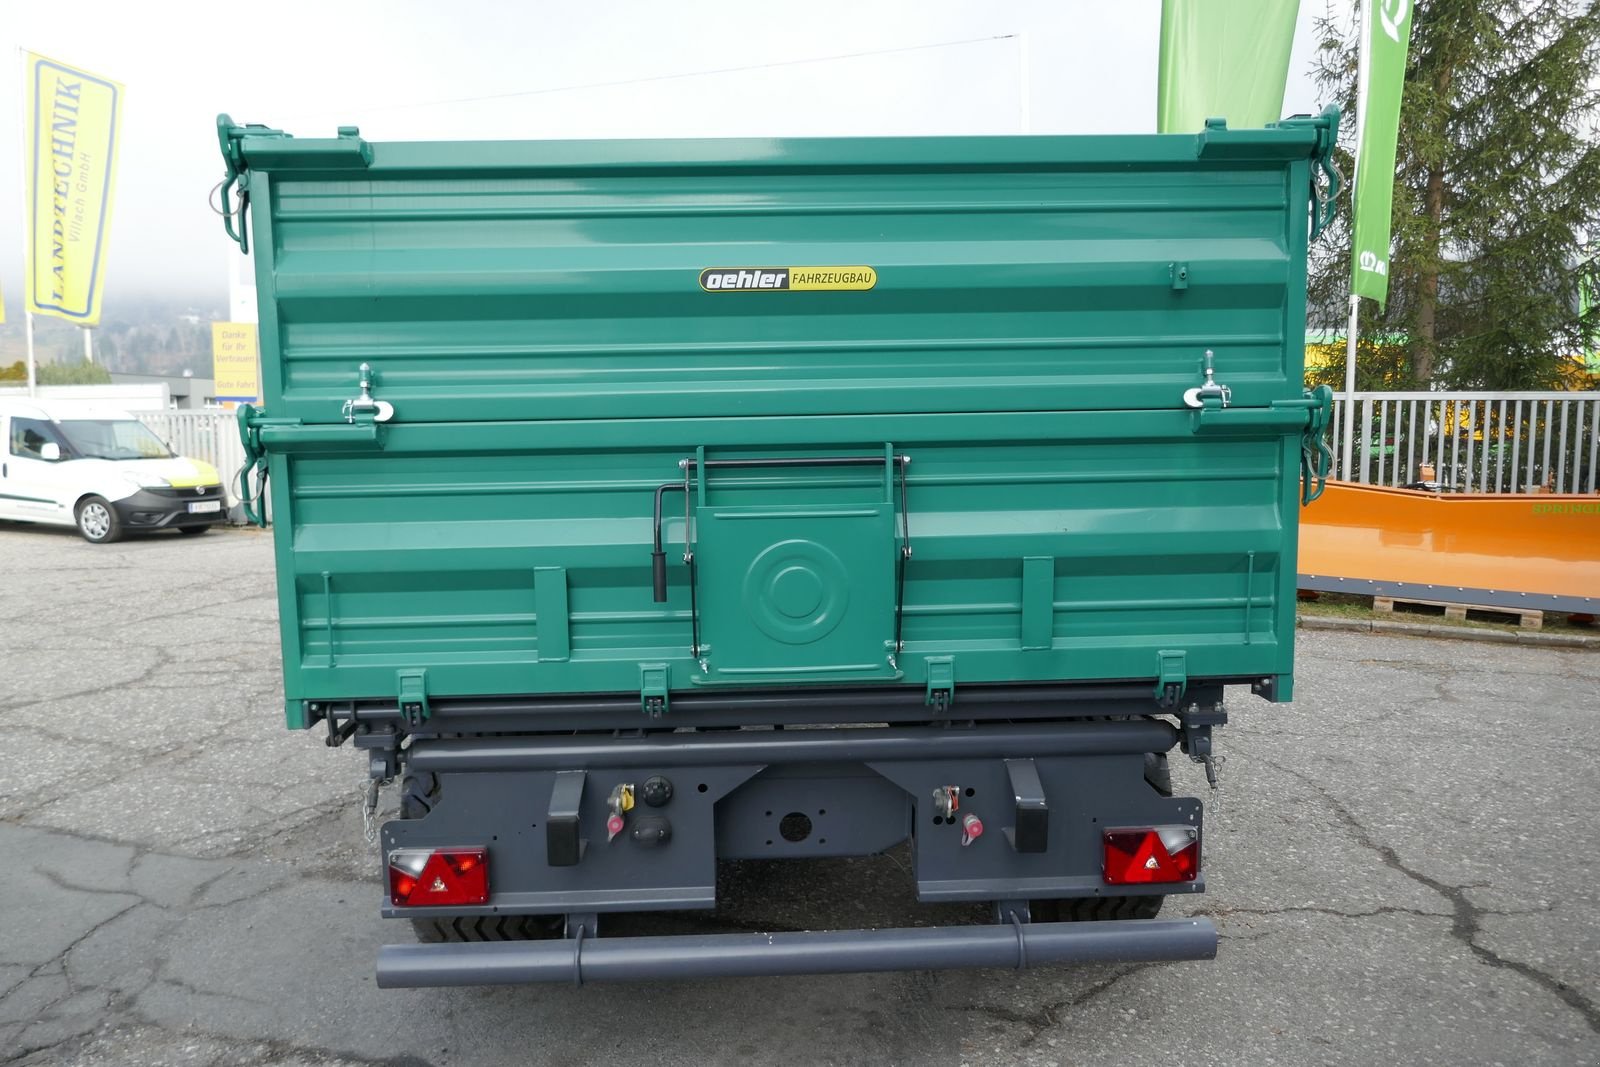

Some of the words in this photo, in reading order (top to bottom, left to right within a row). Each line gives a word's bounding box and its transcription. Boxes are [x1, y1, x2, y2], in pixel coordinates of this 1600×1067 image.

[51, 76, 82, 302] LANDTECHNIK
[67, 197, 85, 243] Villach
[77, 153, 92, 193] GmbH
[706, 270, 786, 289] oehler
[792, 272, 872, 284] FAHRZEUGBAU
[222, 330, 247, 339] Danke
[216, 354, 255, 363] Vertrauen
[217, 380, 234, 388] Gute
[236, 380, 255, 388] Fahrt
